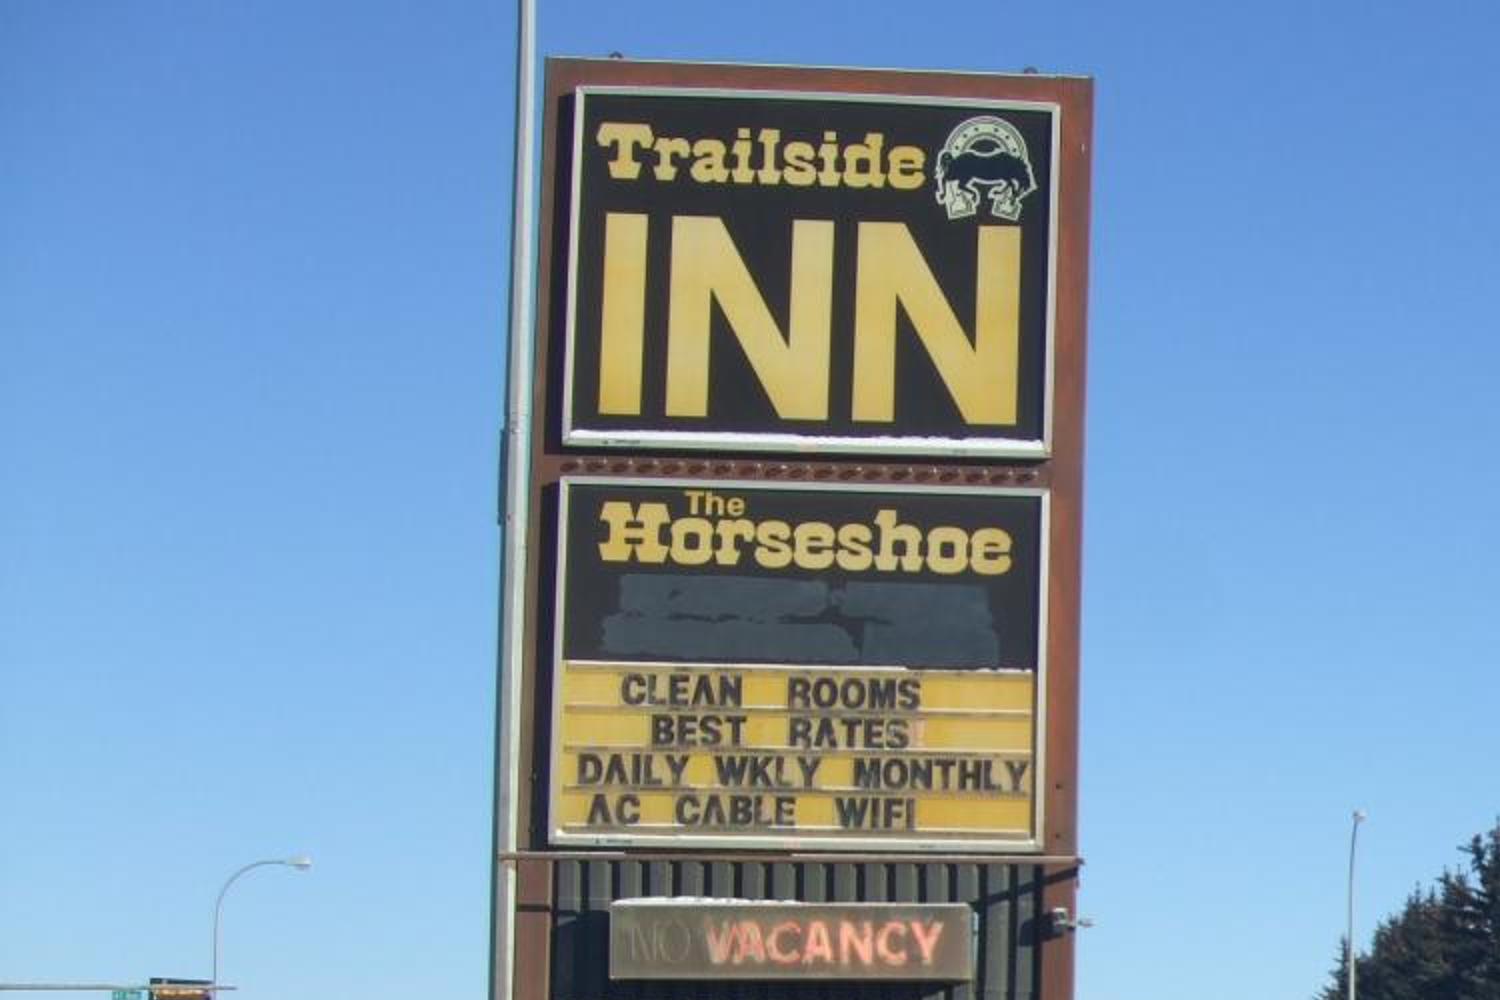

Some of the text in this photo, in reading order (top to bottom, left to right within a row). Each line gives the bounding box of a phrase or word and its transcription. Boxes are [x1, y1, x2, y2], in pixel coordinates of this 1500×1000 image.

[597, 122, 926, 189] Trailside
[598, 212, 1022, 425] INN
[684, 489, 746, 517] The
[598, 501, 1013, 575] Horseshoe
[621, 674, 921, 711] CLEAN ROOMS
[651, 714, 910, 749] BEST RATES
[577, 753, 1028, 792] DAILY WKLY MONTHLY
[586, 793, 916, 830] AC CABLE WIFI
[628, 919, 945, 965] NO VACANCY
